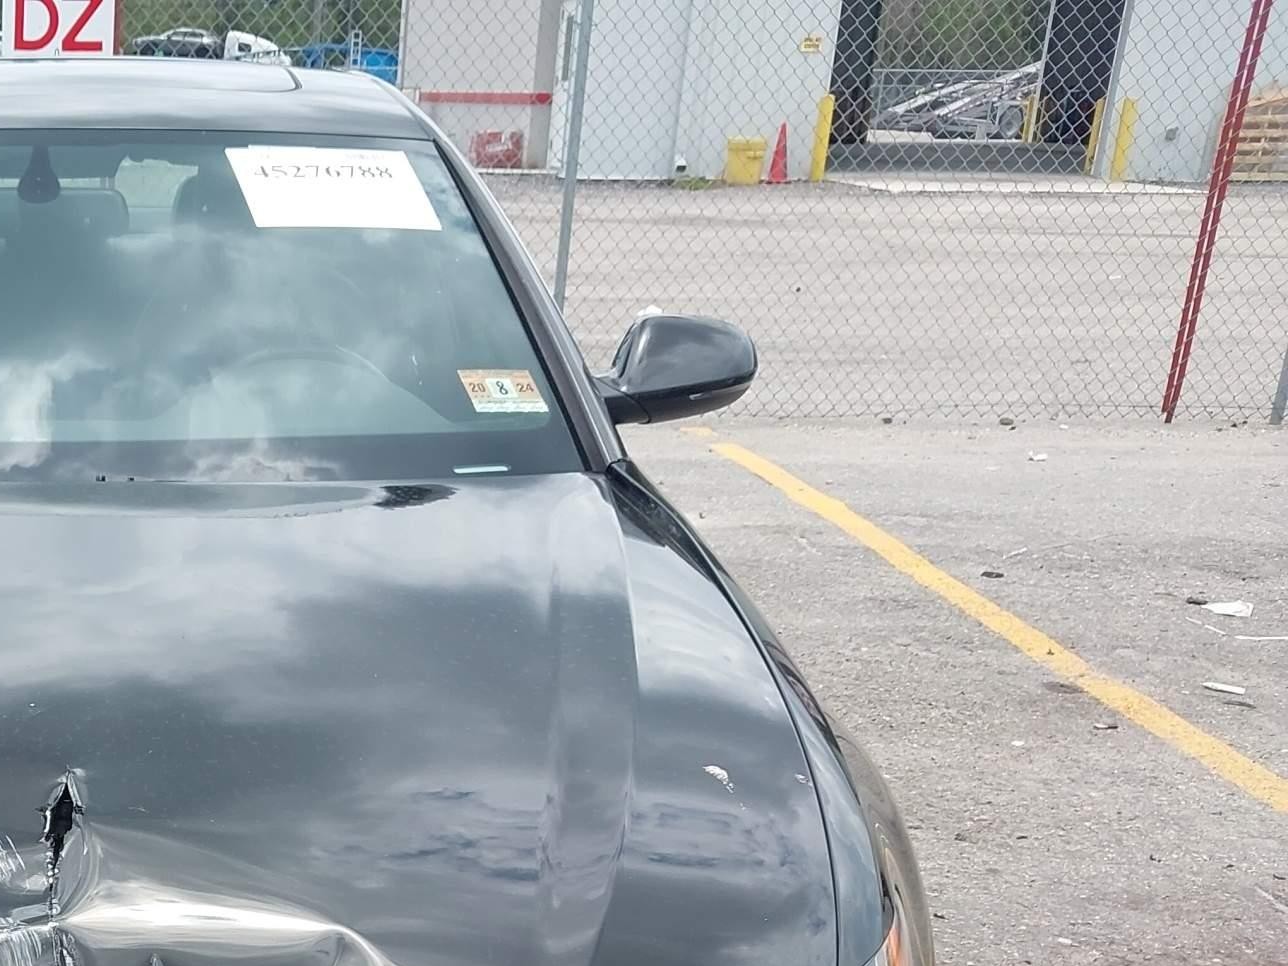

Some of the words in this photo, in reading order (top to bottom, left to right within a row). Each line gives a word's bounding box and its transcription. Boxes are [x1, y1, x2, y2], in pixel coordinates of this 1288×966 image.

[14, 0, 103, 51] DZ
[254, 164, 393, 179] 45276788
[469, 382, 486, 393] 20
[495, 380, 509, 396] 8
[516, 382, 534, 393] 24
